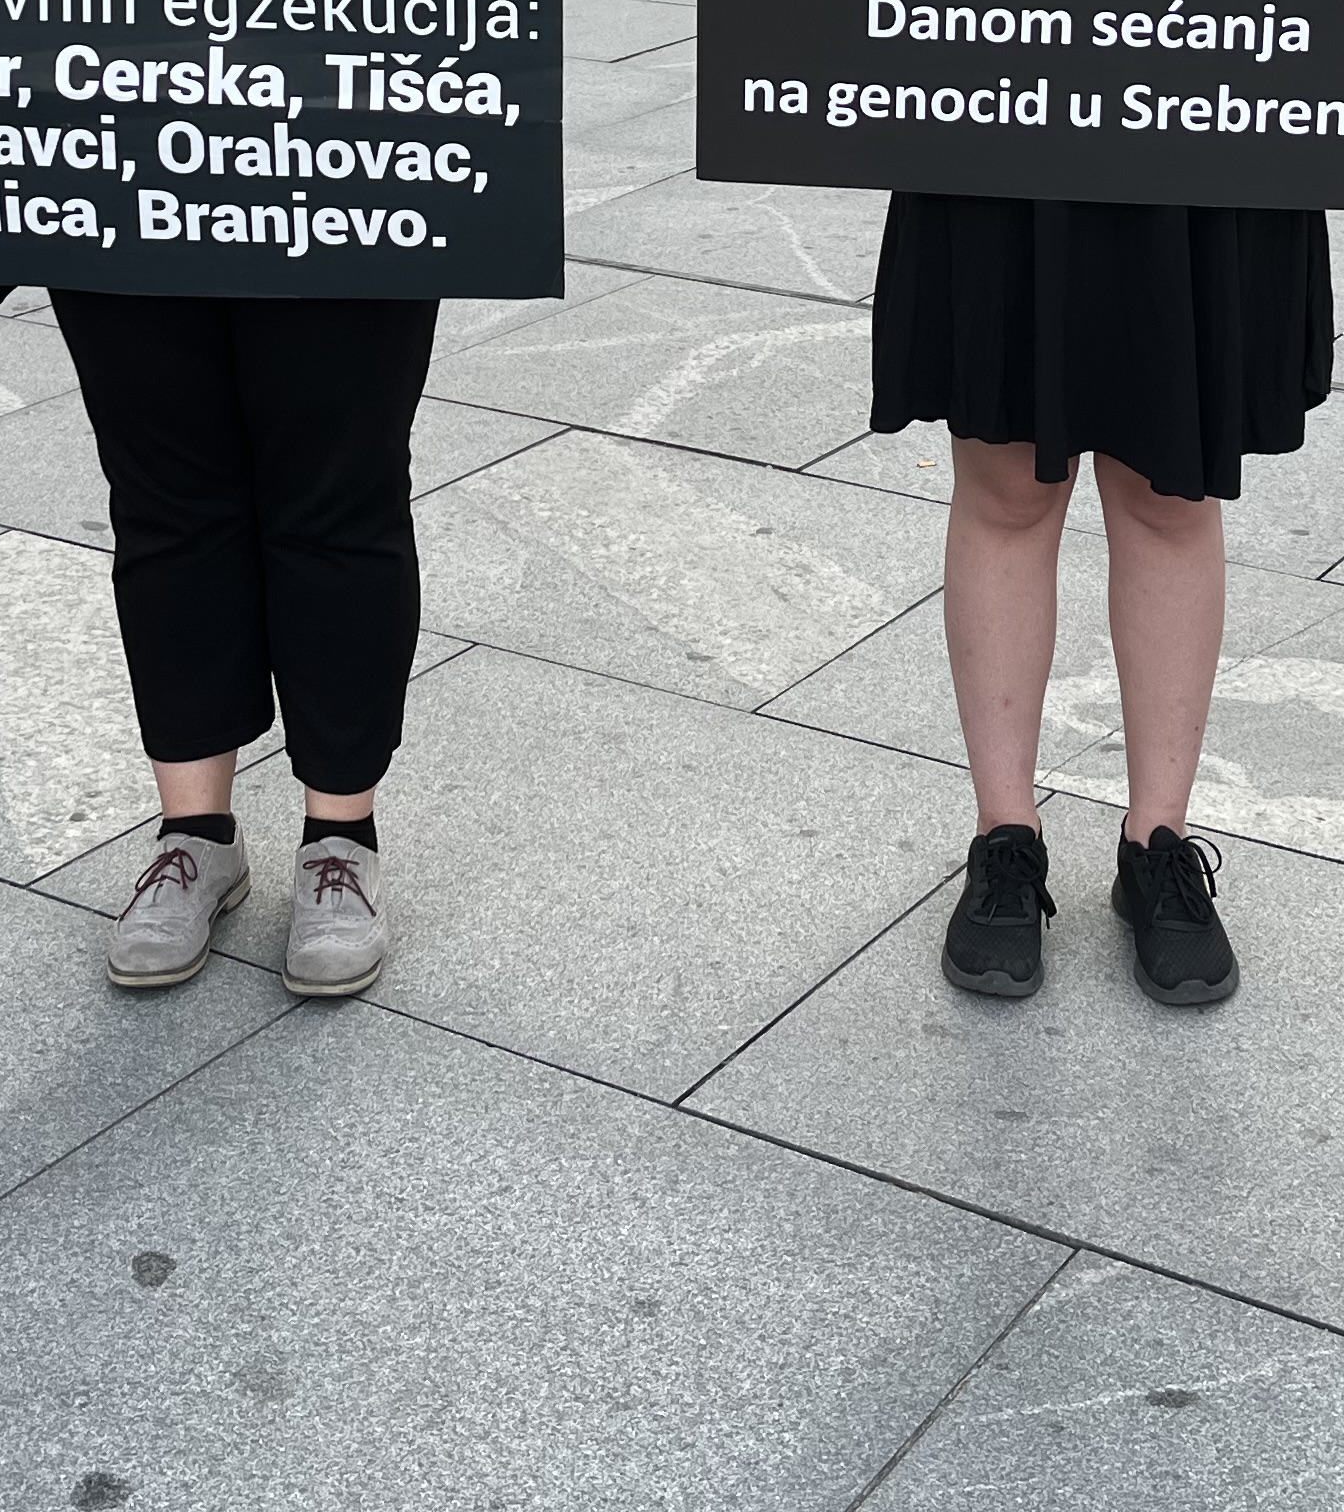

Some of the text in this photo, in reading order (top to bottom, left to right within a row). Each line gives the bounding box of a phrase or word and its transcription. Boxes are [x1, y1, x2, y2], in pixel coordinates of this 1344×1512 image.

[1092, 0, 1310, 63] sećanja
[54, 44, 303, 120] Cerska,
[325, 53, 521, 127] Tišća,
[744, 78, 808, 114] na
[826, 77, 1048, 128] genocid
[1069, 93, 1102, 128] u
[157, 120, 488, 194] Orahovac,
[137, 188, 447, 258] Branjevo.
